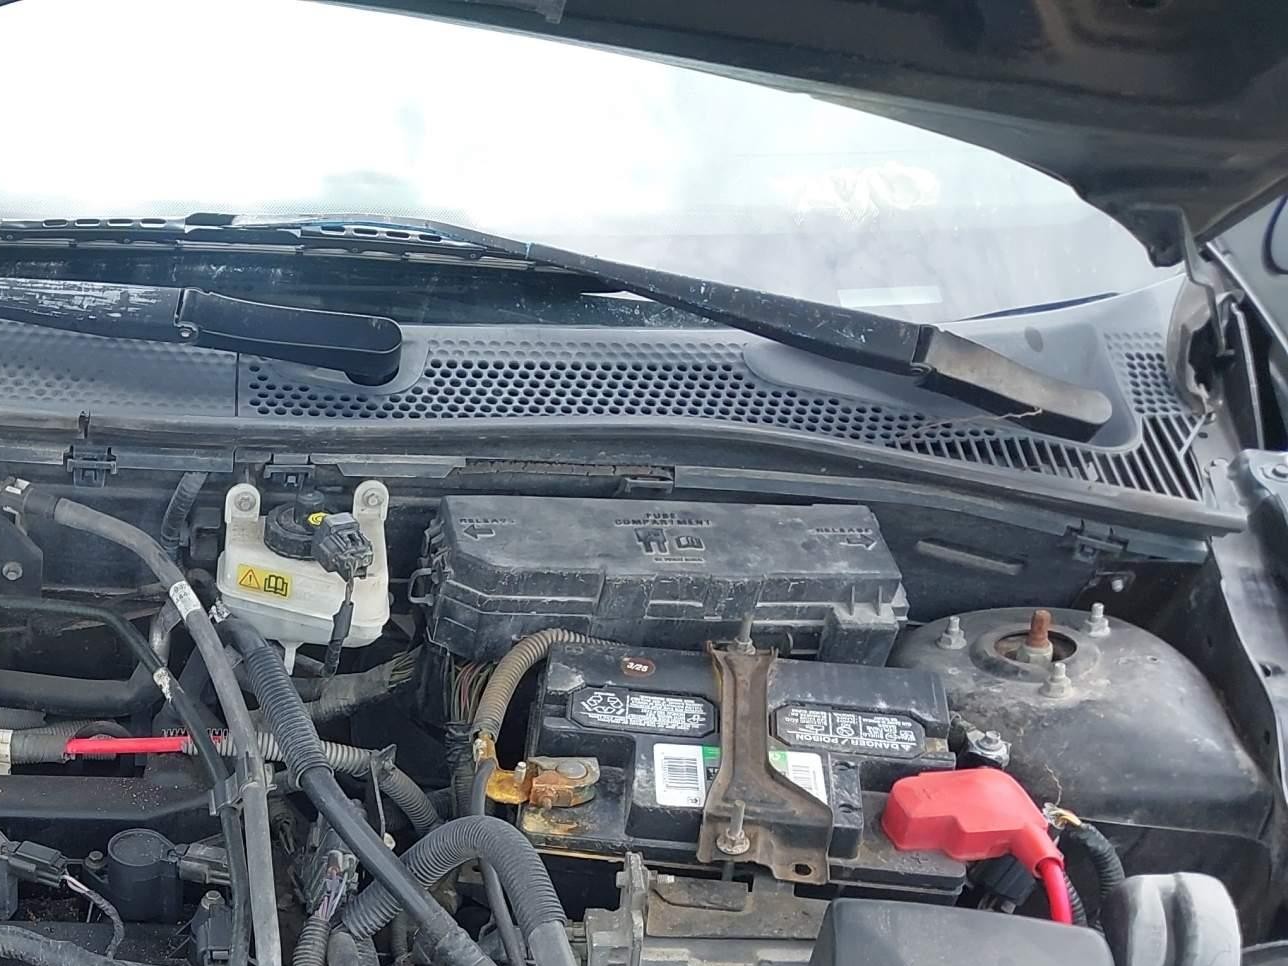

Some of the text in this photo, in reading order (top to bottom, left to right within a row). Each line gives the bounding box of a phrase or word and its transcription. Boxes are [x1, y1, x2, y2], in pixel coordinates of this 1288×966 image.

[614, 519, 712, 528] COMPARTMENT
[796, 733, 839, 745] POISON
[851, 739, 900, 750] DANGER
